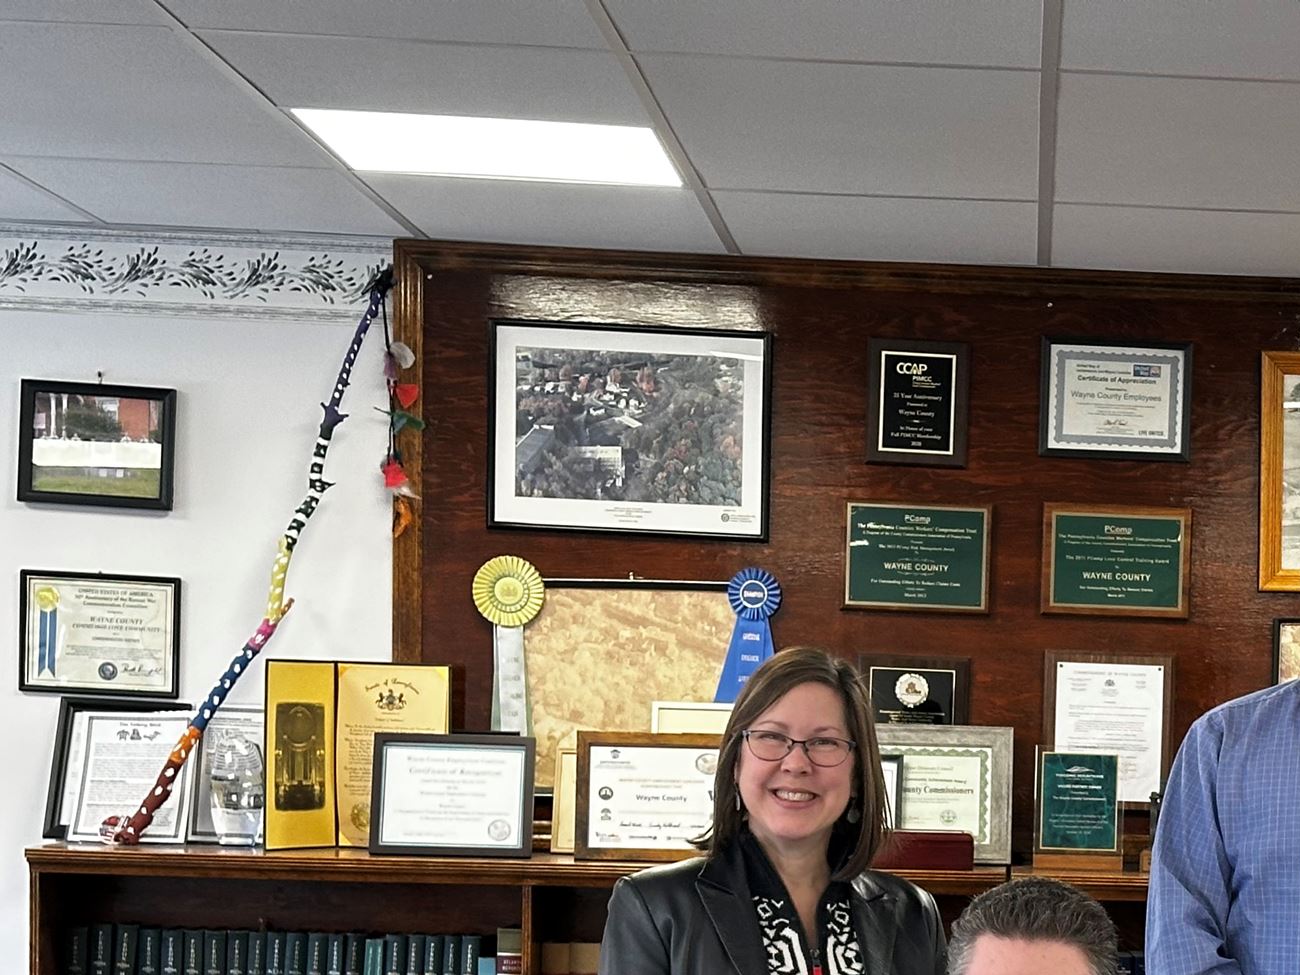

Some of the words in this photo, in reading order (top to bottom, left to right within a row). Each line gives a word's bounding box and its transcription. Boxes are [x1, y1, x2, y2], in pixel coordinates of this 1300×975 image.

[896, 362, 928, 374] CCAP
[1071, 391, 1095, 399] Wayne
[1097, 391, 1121, 400] County
[1124, 393, 1161, 403] Employees
[905, 515, 931, 524] PComp
[1105, 525, 1132, 535] PComp
[884, 562, 912, 570] WAYNE
[914, 563, 948, 572] COUNTY
[1083, 572, 1112, 580] WAYNE
[1115, 573, 1151, 581] COUNTY
[903, 787, 922, 795] ounty
[924, 786, 974, 795] Commissioners
[636, 794, 659, 802] Wayne
